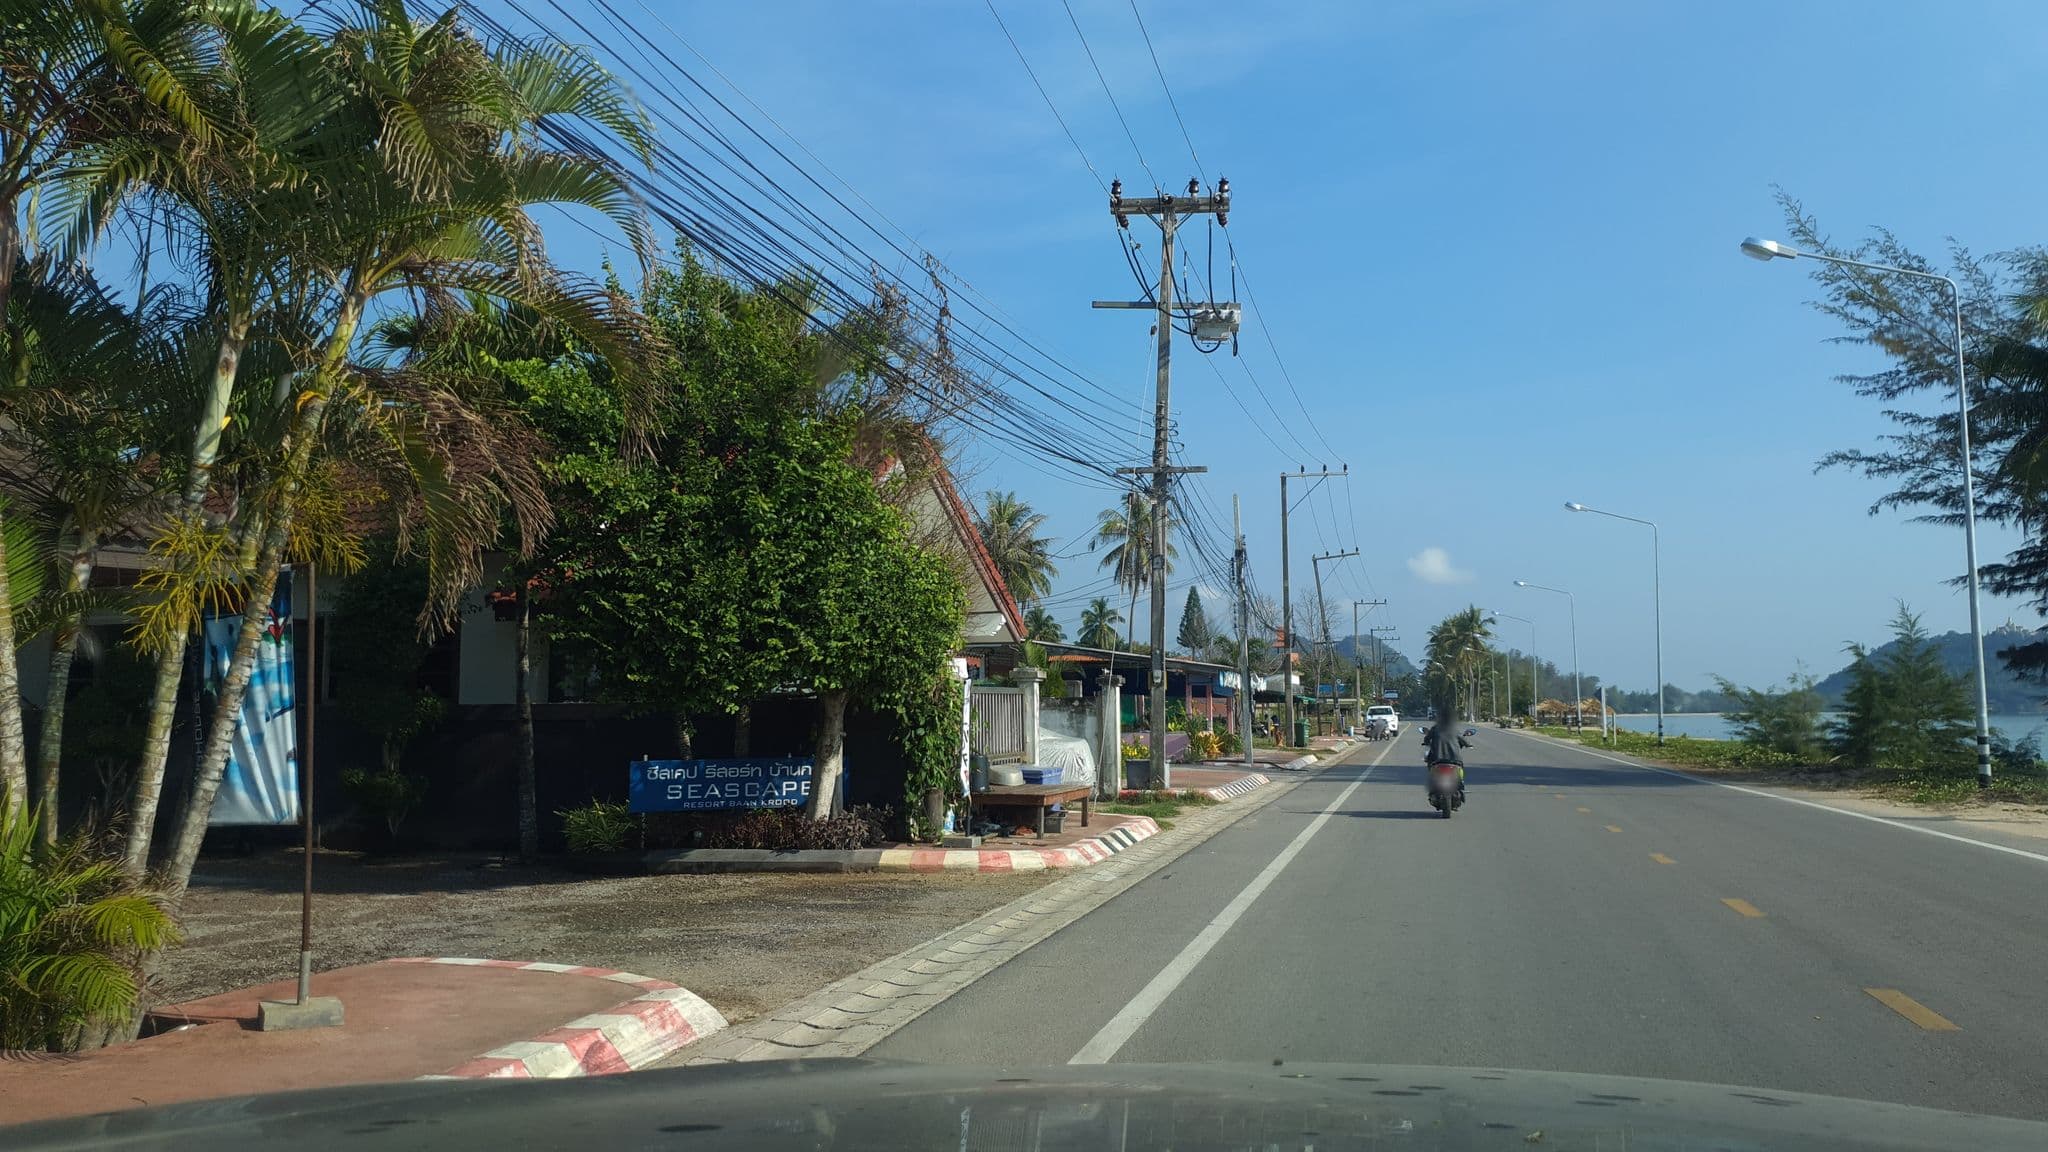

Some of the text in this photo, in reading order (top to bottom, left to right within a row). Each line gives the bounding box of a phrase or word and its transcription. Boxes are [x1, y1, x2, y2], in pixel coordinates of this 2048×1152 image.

[705, 762, 761, 778] รีสอร์ท
[667, 780, 811, 800] SEASCAPE
[683, 801, 725, 809] RESORT
